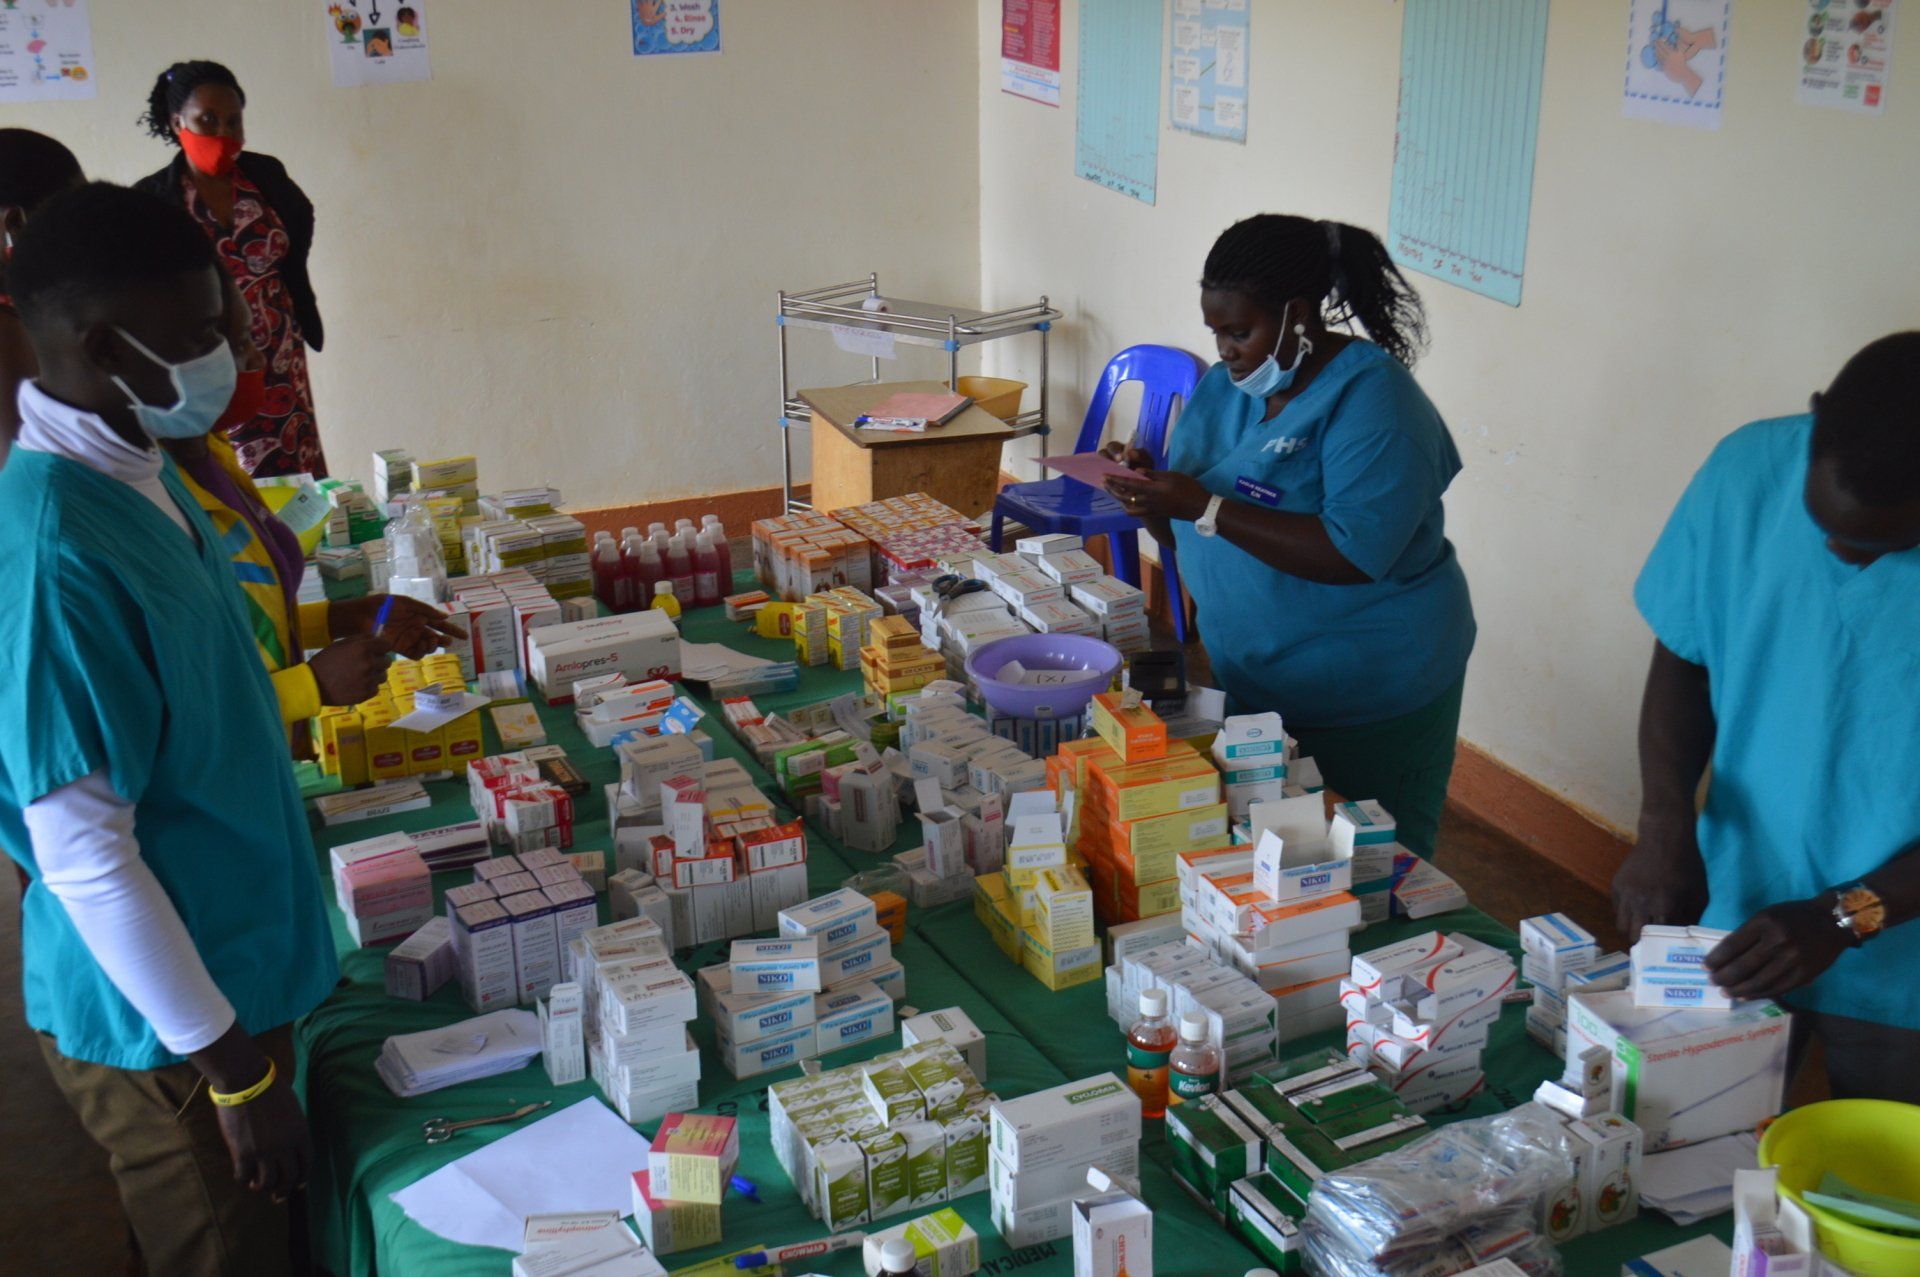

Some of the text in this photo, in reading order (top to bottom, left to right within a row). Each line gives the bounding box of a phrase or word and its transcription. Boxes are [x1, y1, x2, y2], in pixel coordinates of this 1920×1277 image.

[680, 27, 695, 35] Dry
[554, 652, 619, 674] Amlopres-5
[827, 923, 852, 941] NIKO
[842, 953, 867, 970] NIKO
[758, 972, 789, 985] NIKO
[1664, 988, 1697, 999] NIKO
[760, 1012, 789, 1029] NIKO
[840, 1020, 868, 1037] NIKO
[761, 1045, 790, 1062] NIKO
[1646, 1050, 1681, 1063] Sterile
[1682, 1034, 1744, 1058] Hypodermic
[981, 1240, 1058, 1277] MEDICAL
